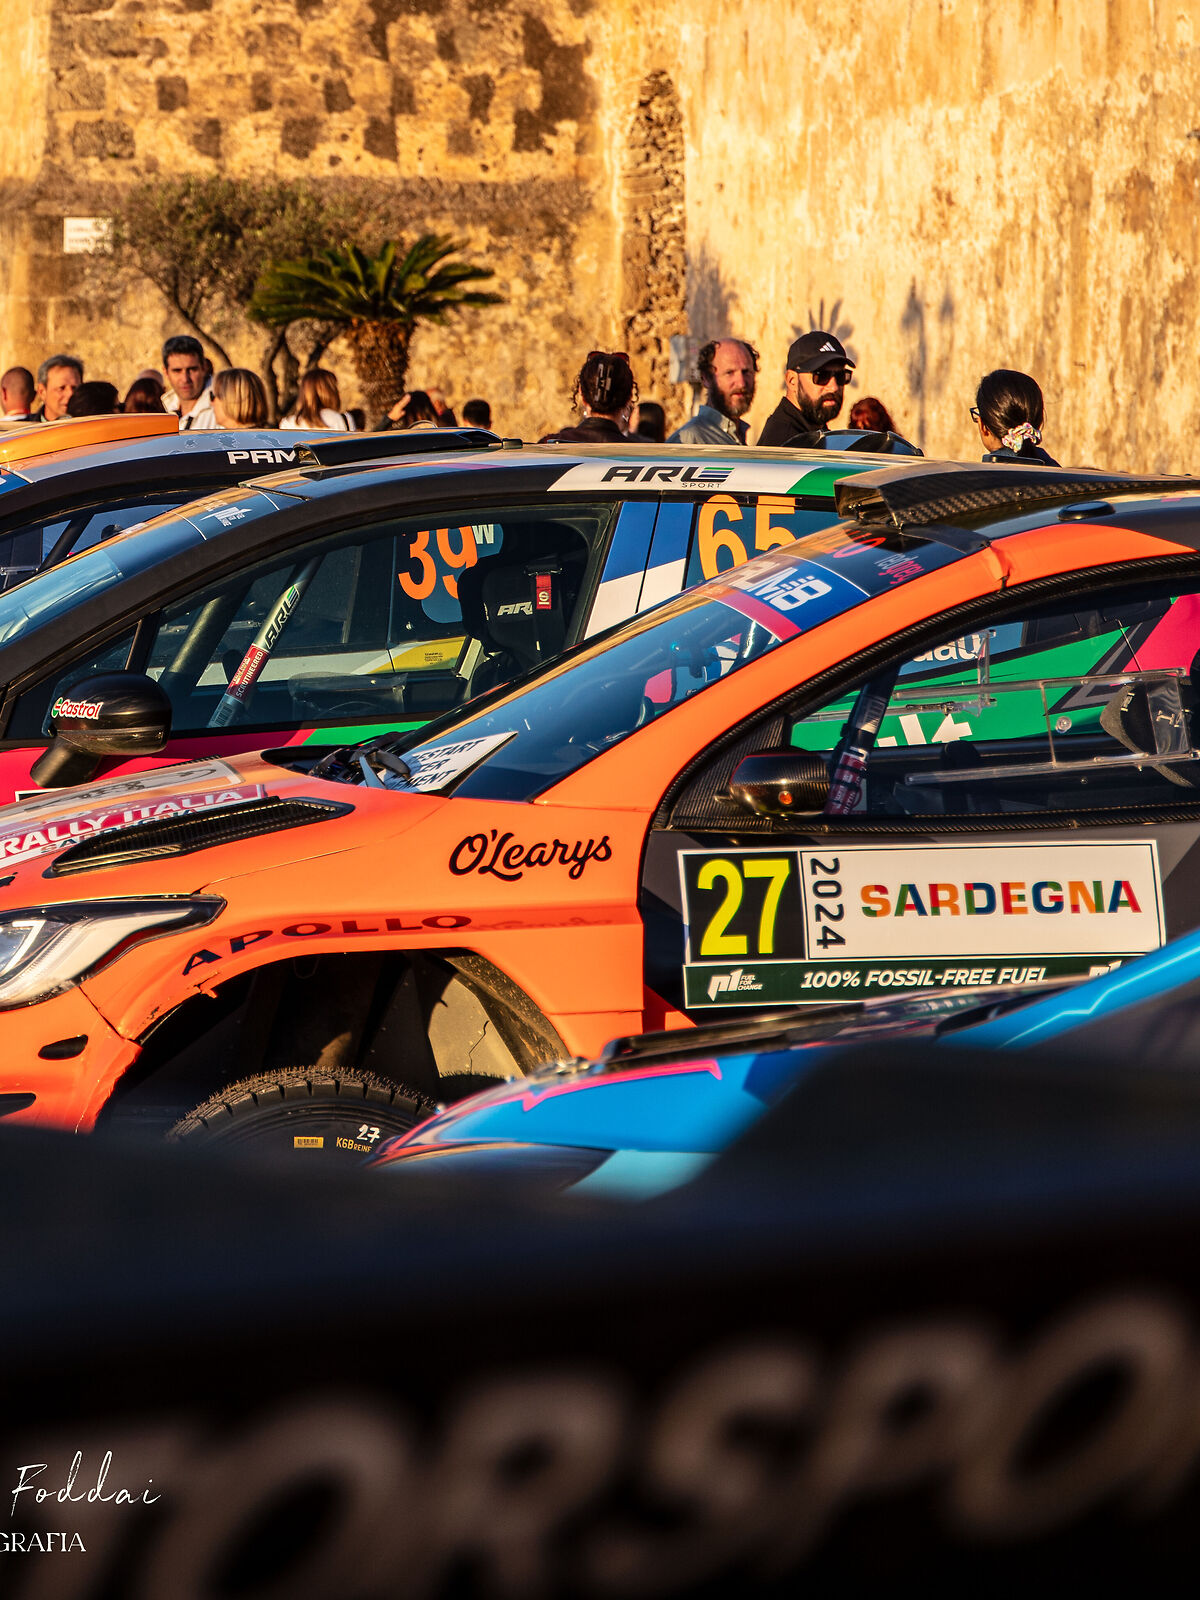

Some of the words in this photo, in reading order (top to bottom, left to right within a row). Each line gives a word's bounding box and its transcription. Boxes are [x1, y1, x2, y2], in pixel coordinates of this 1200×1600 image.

[698, 494, 798, 580] 65
[236, 651, 263, 697] SCRUTINEERED
[60, 699, 103, 719] Castrol
[123, 791, 243, 823] ITALIA
[448, 829, 613, 881] O'Learys
[697, 858, 790, 957] 27
[809, 857, 846, 950] 2024
[860, 880, 1142, 917] SARDEGNA
[182, 914, 472, 976] APOLLO
[801, 971, 861, 988] 100%
[865, 967, 996, 987] FOSSIL-FREE
[998, 967, 1049, 985] FUEL
[356, 1124, 380, 1143] 27
